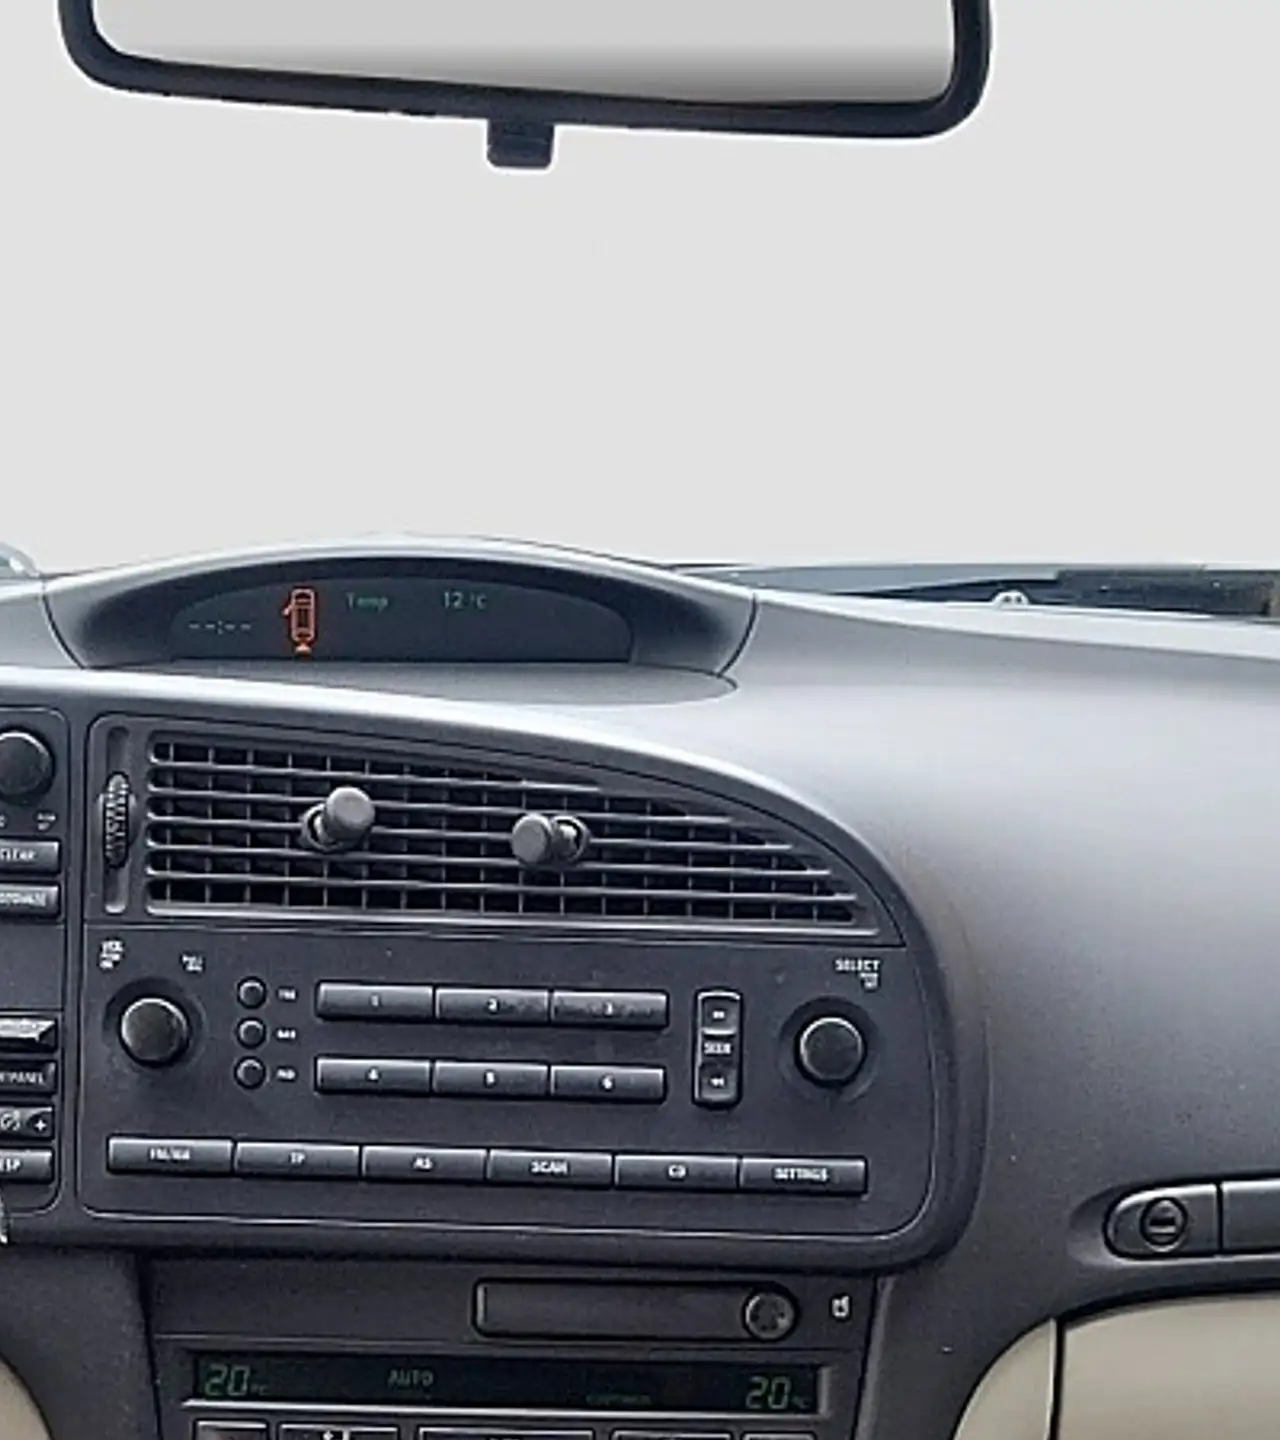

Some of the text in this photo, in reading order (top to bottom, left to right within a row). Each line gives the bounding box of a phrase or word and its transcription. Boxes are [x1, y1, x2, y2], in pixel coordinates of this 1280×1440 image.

[346, 591, 389, 613] Temp
[443, 590, 464, 610] 12
[834, 958, 882, 972] SELECT
[487, 997, 499, 1012] 2
[602, 1075, 614, 1090] 6
[531, 1160, 569, 1175] SCAN
[203, 1363, 252, 1397] 20
[387, 1368, 434, 1388] AUTO
[744, 1375, 792, 1410] 20
